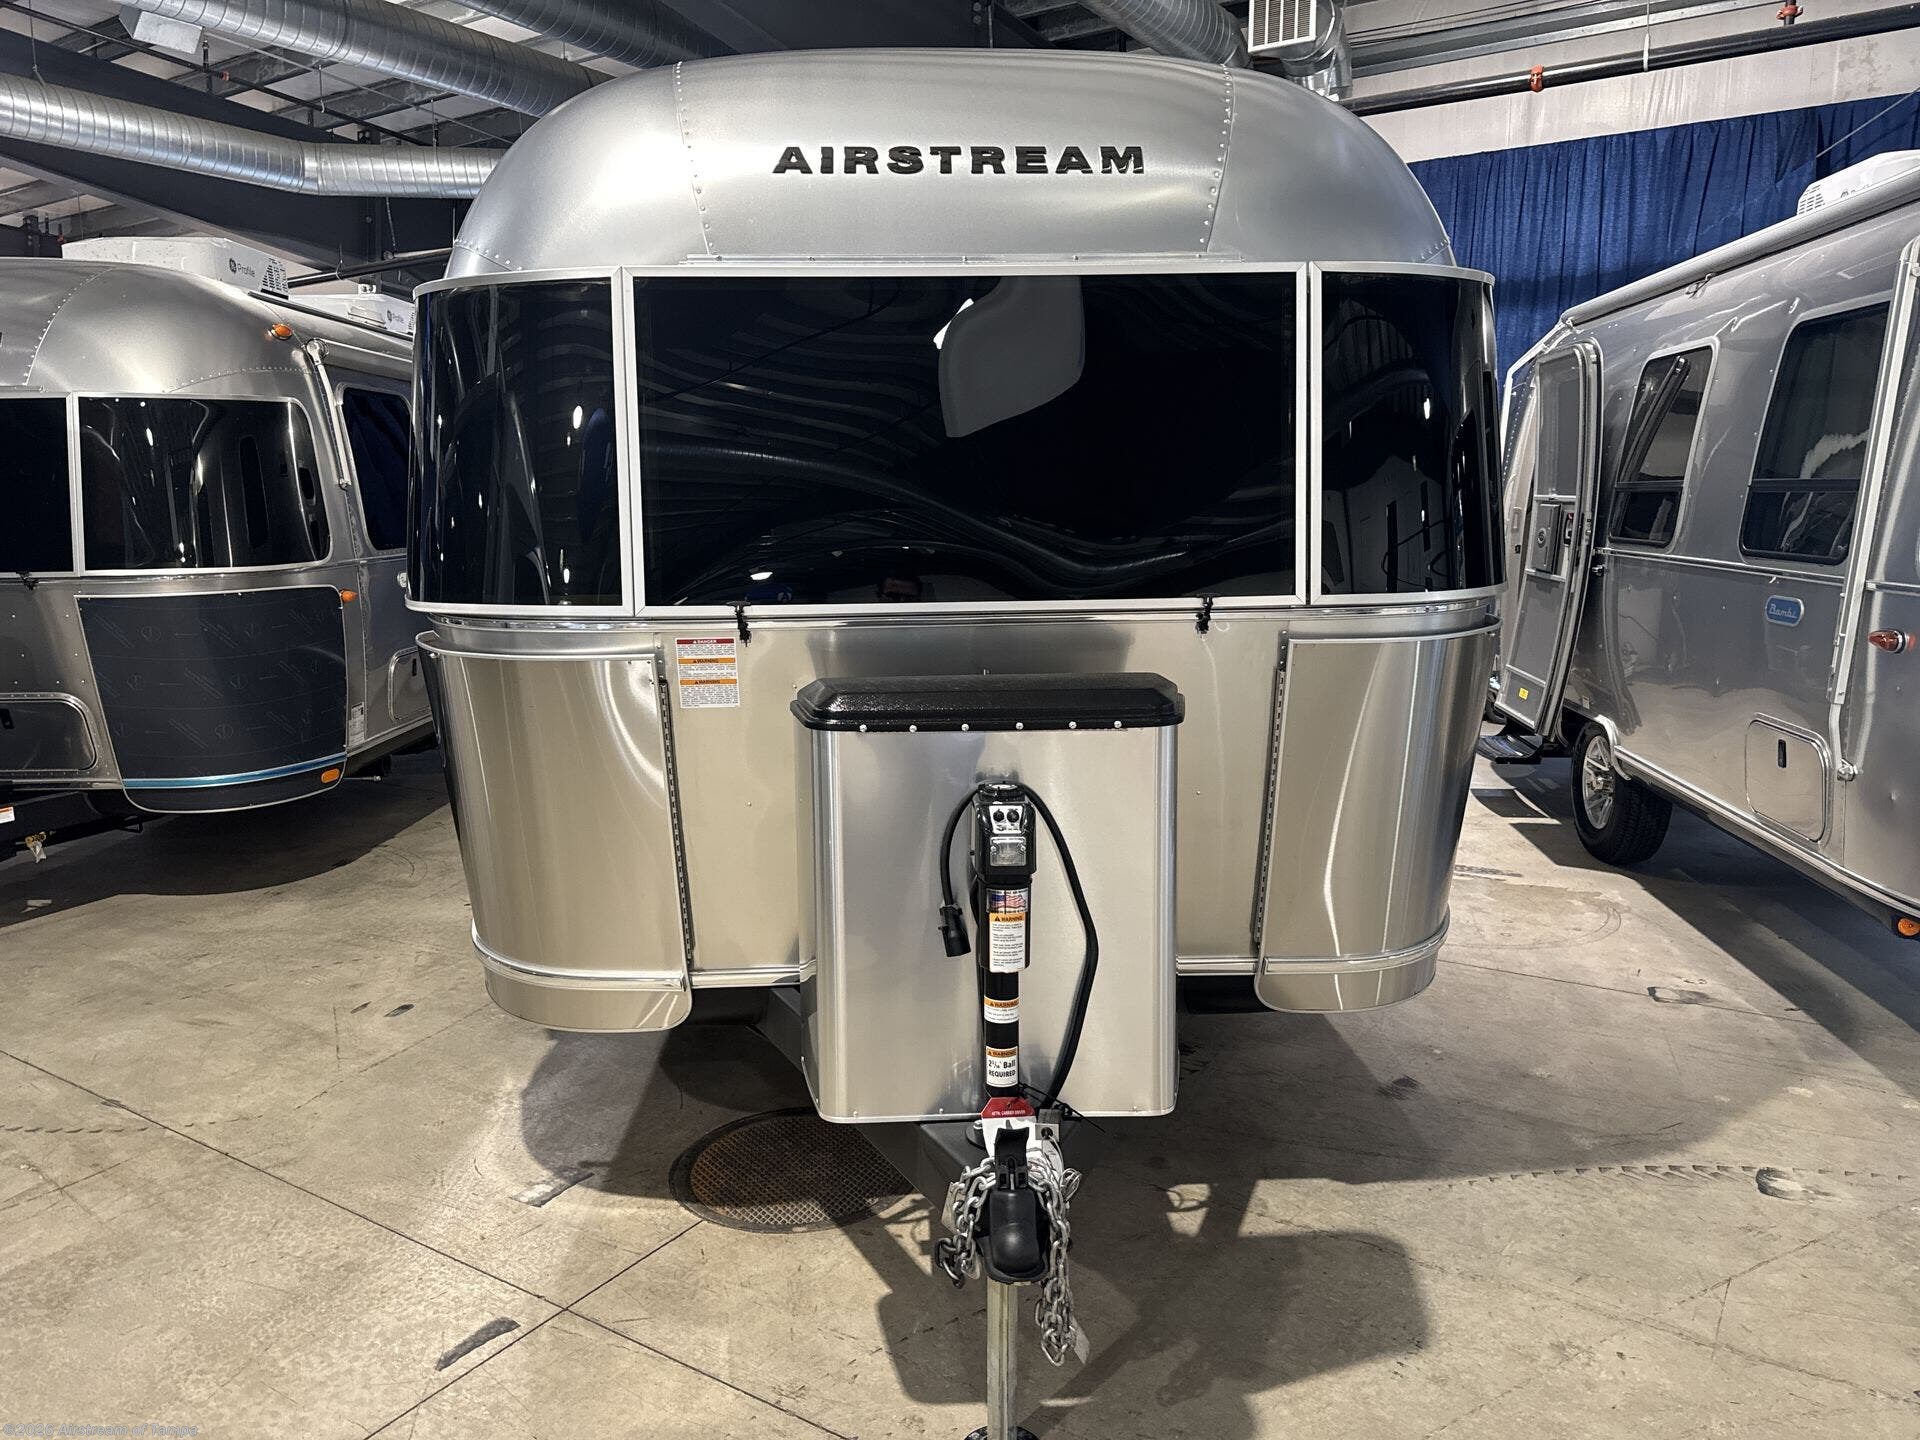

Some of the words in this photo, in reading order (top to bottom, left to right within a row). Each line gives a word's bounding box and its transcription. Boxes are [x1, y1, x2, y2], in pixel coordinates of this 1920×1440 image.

[773, 146, 1145, 174] AIRSTREAM
[238, 263, 255, 278] Profile
[1768, 604, 1797, 618] Bambi
[1003, 1060, 1016, 1069] Ball
